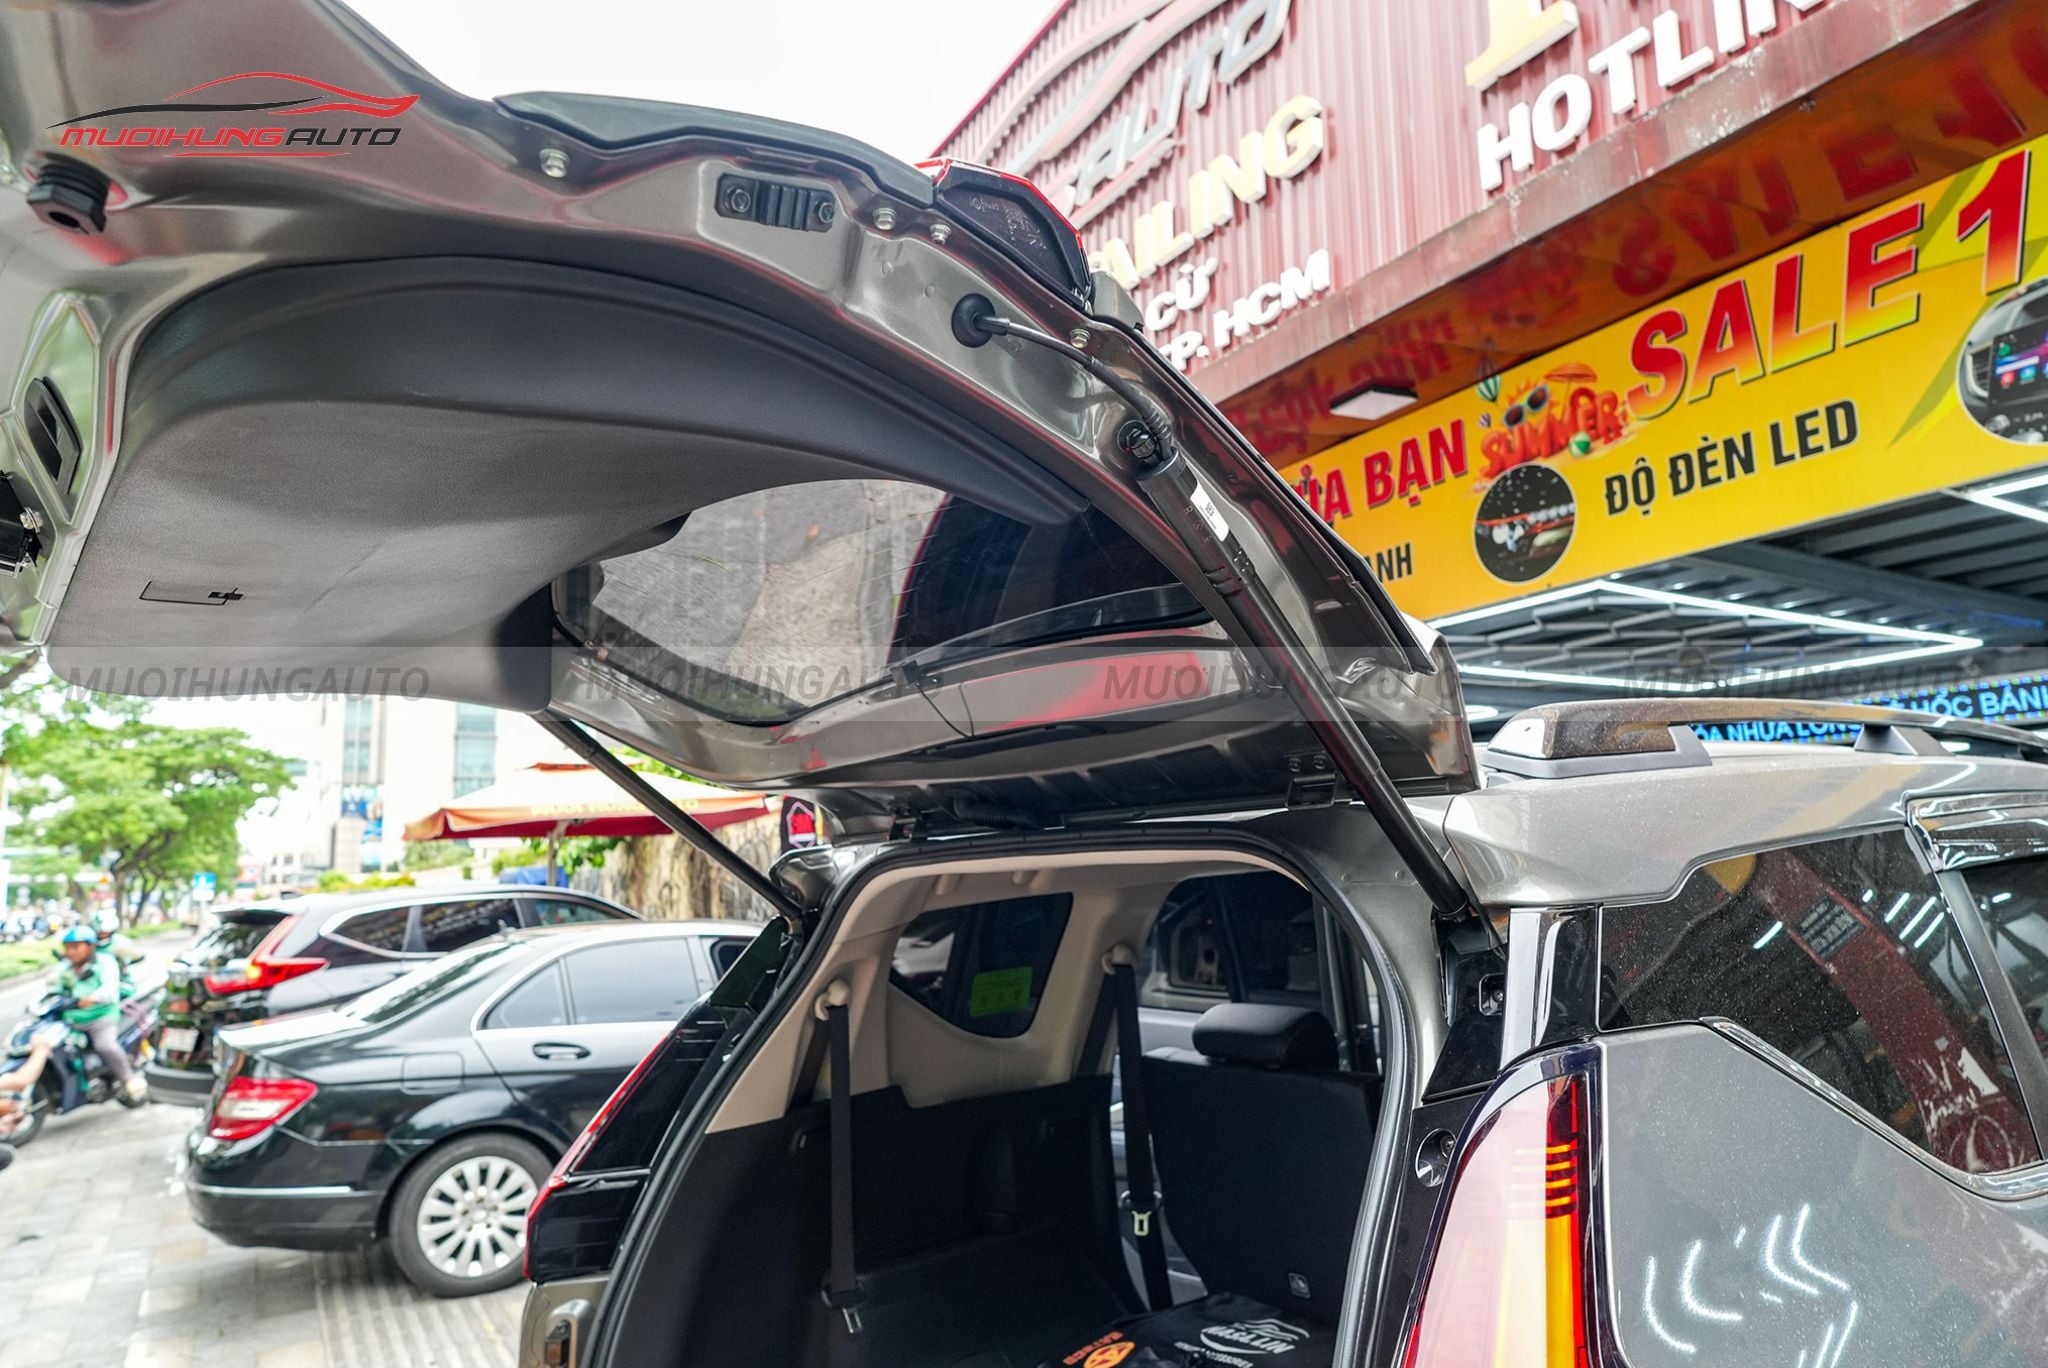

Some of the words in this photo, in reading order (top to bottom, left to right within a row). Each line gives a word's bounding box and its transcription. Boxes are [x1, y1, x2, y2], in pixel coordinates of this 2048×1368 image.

[1087, 95, 1323, 289] AILING
[1213, 248, 1330, 348] HCM
[1625, 201, 1925, 420] SALE
[1363, 419, 1468, 509] BẠN
[1604, 457, 1655, 516] ĐỘ
[1668, 431, 1756, 497] ĐÈN
[1769, 400, 1858, 466] LED
